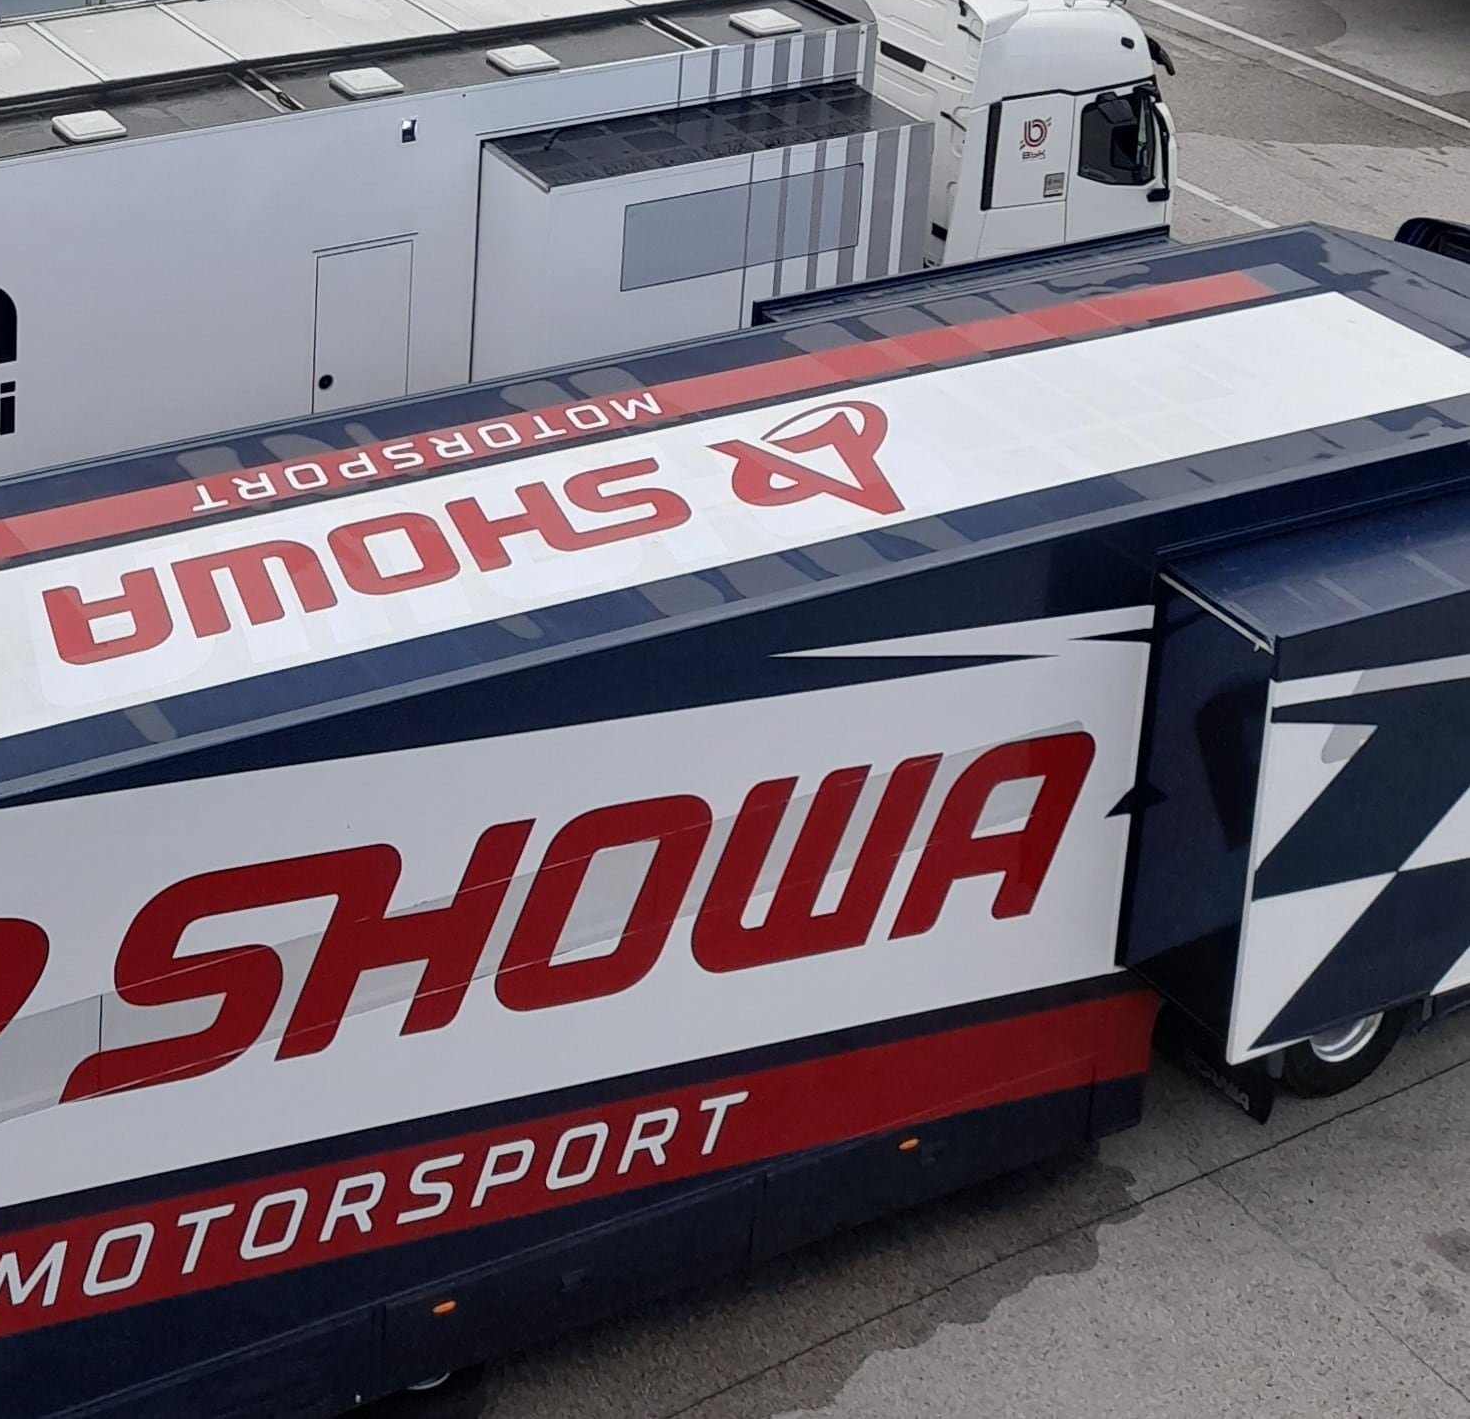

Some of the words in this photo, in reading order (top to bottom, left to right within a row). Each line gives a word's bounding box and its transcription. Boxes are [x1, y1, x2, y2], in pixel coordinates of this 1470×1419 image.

[190, 391, 664, 514] MOTORSPORT
[41, 457, 694, 666] SHOWA
[59, 728, 1098, 1104] SHOWA
